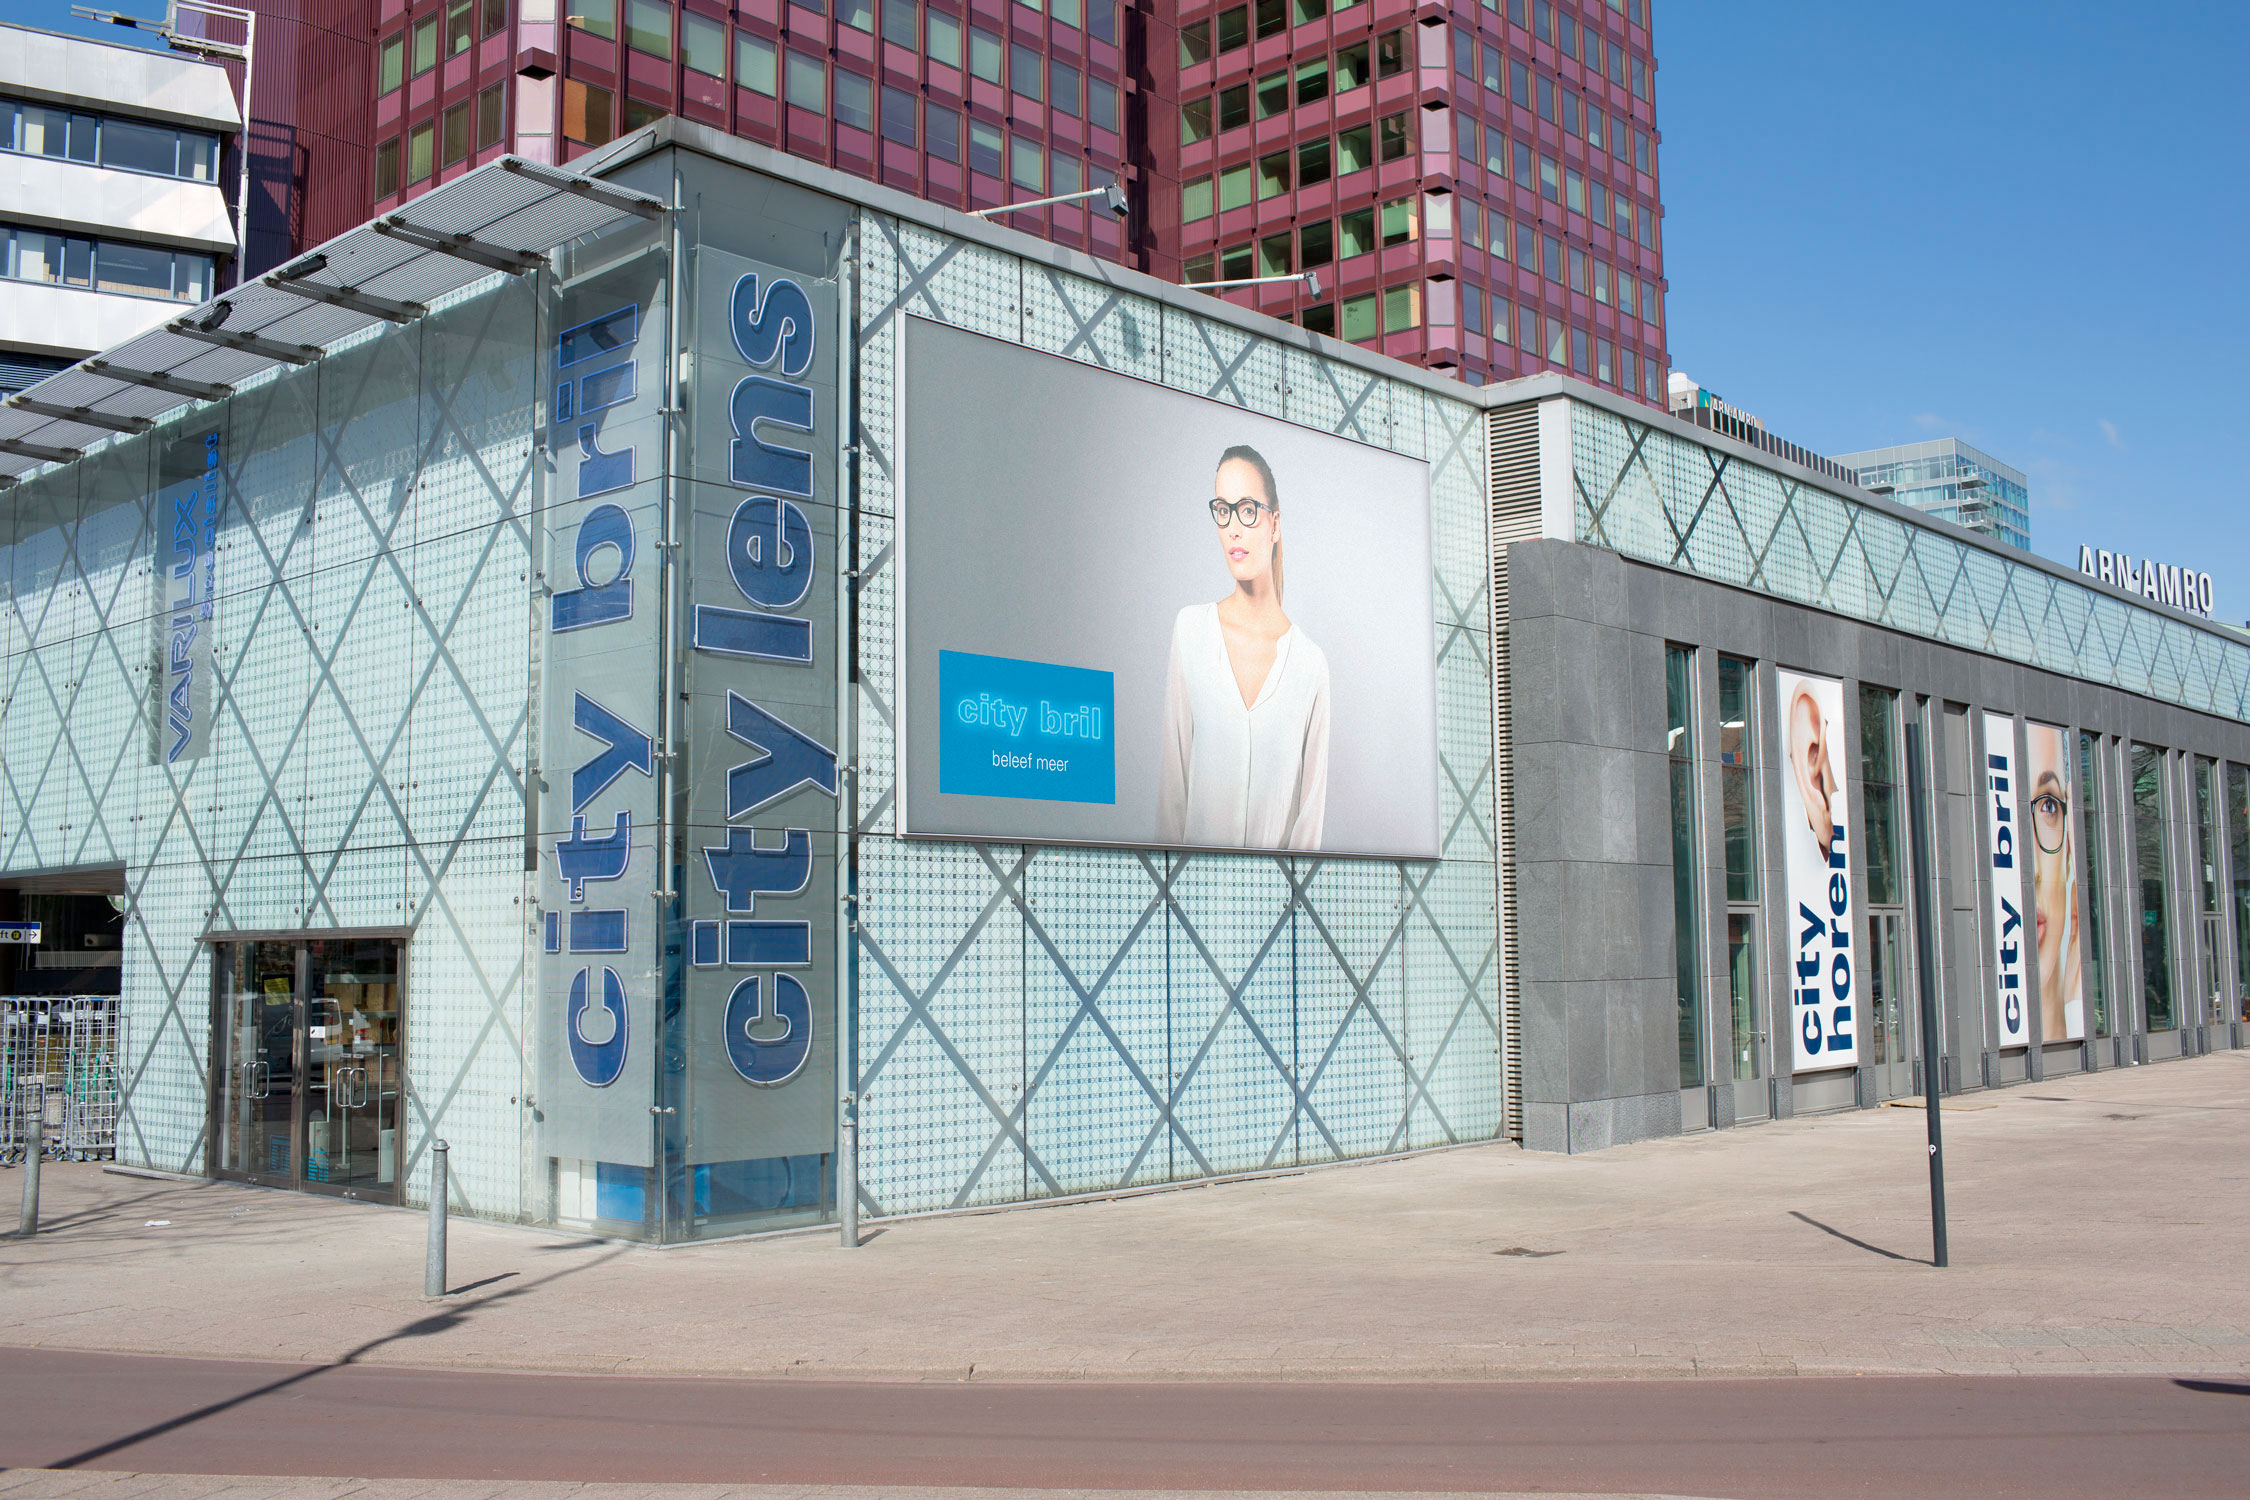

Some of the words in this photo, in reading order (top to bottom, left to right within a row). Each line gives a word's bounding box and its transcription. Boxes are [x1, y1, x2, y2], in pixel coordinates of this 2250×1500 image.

[551, 302, 640, 632] bril
[693, 272, 816, 664] lens
[167, 489, 199, 764] VARILUX
[958, 693, 1028, 737] city
[1040, 701, 1101, 740] bril
[992, 750, 1033, 769] beleef
[1036, 757, 1069, 772] meer
[1988, 753, 2013, 869] bril
[544, 689, 654, 1087] city
[693, 688, 838, 1085] city
[1794, 901, 1826, 1056] city
[1827, 824, 1853, 1052] horen
[1999, 896, 2022, 1035] city
